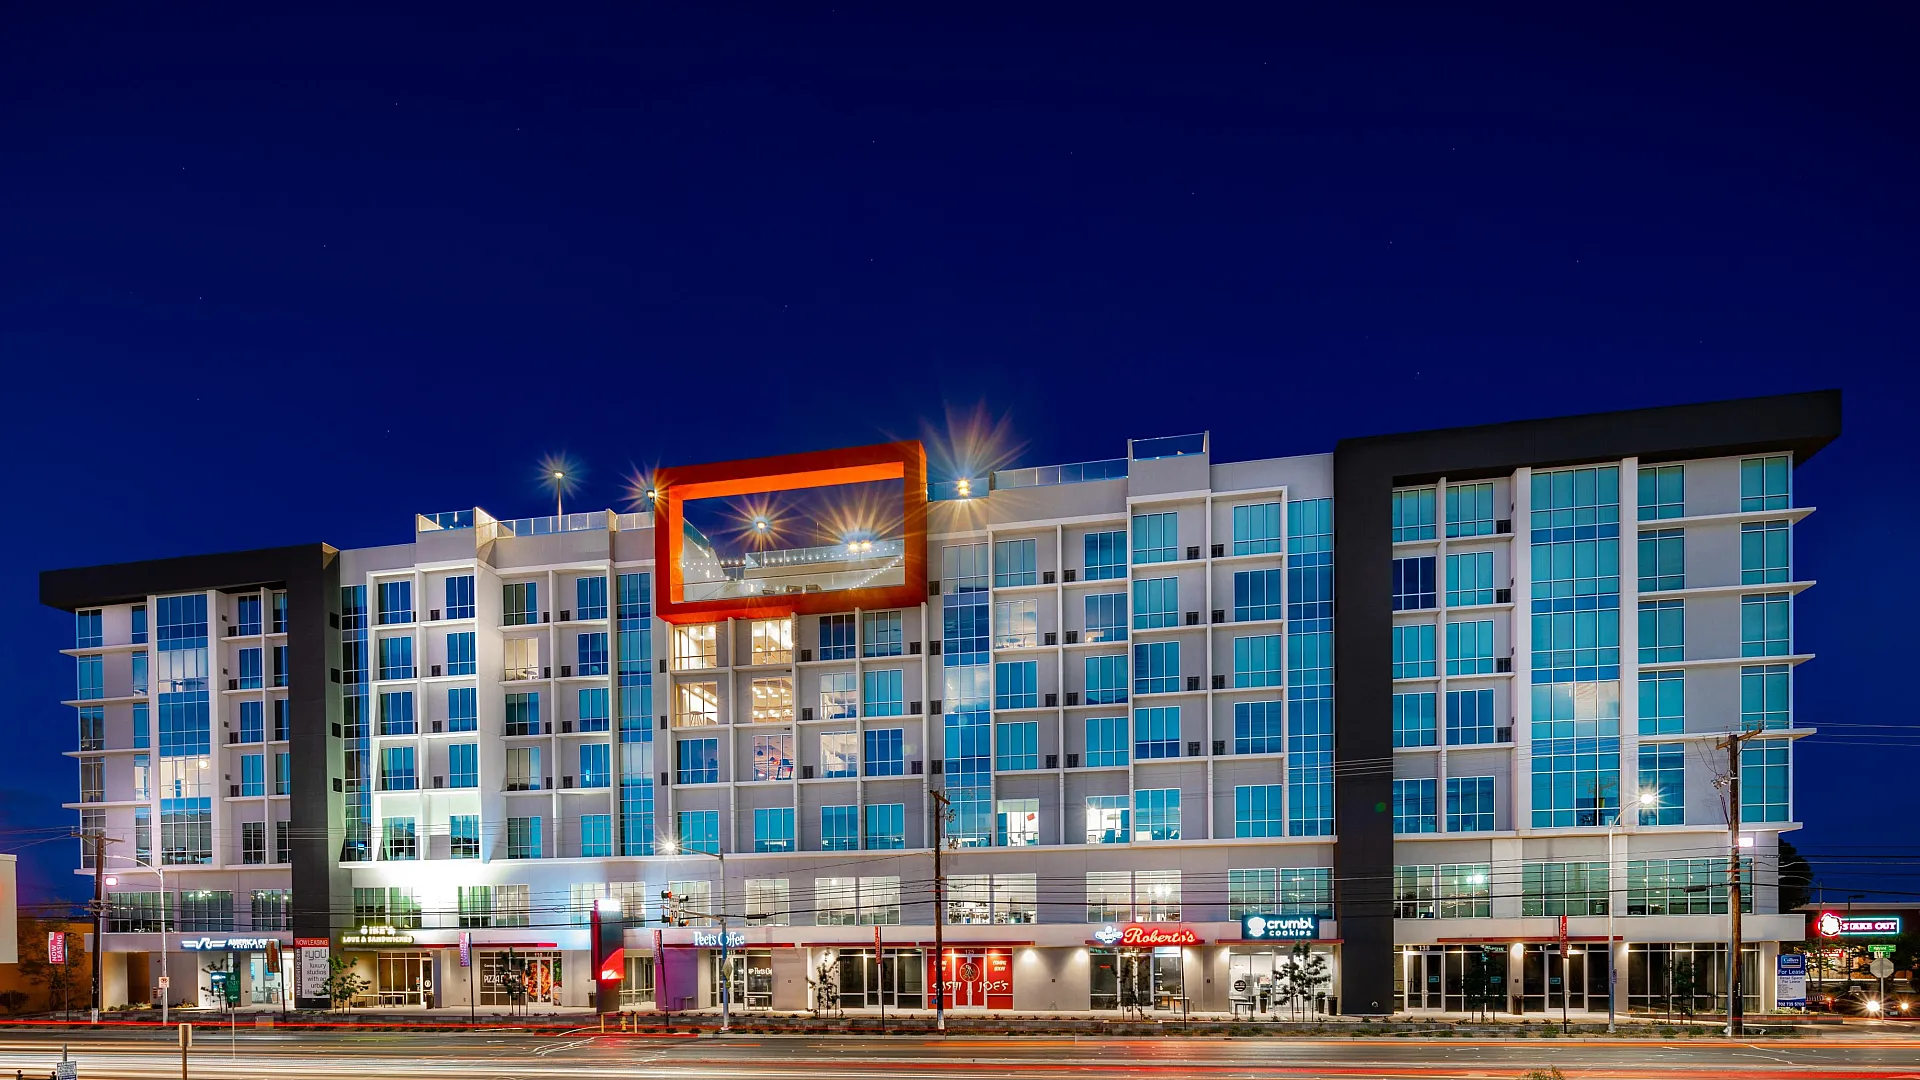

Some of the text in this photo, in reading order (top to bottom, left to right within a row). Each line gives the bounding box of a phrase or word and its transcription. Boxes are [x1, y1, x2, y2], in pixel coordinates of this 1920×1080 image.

[1266, 917, 1314, 929] crumbl
[1875, 922, 1897, 930] OUT
[693, 931, 717, 946] Peet's
[1123, 927, 1196, 944] Roberto's
[483, 974, 500, 983] PIZZA
[978, 980, 1009, 992] JOE'S
